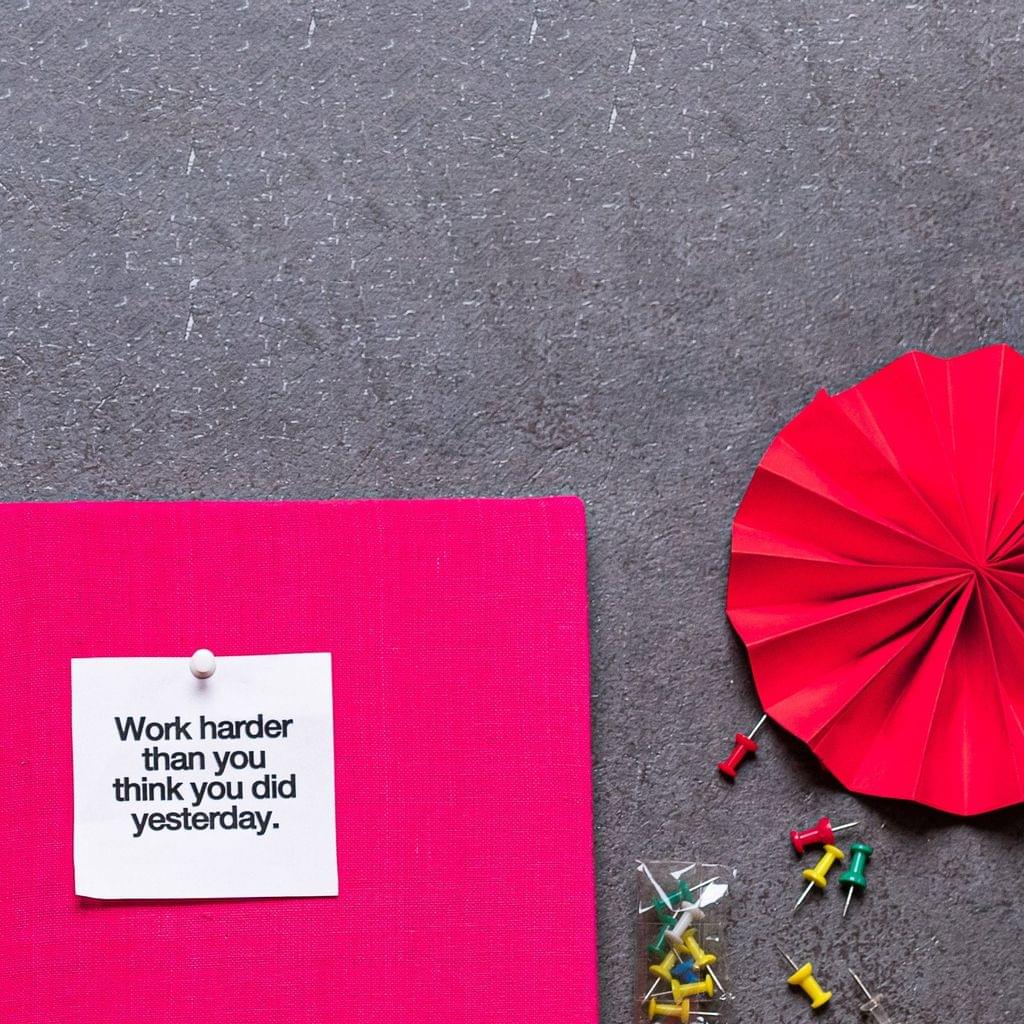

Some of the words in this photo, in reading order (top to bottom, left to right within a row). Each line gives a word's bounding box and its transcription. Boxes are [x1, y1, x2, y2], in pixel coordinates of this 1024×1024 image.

[114, 716, 193, 741] Work
[200, 714, 293, 739] harder
[142, 747, 205, 771] than
[213, 751, 266, 775] you
[113, 776, 184, 801] think
[190, 782, 243, 806] you
[252, 774, 296, 799] did
[131, 805, 279, 837] yesterday.
